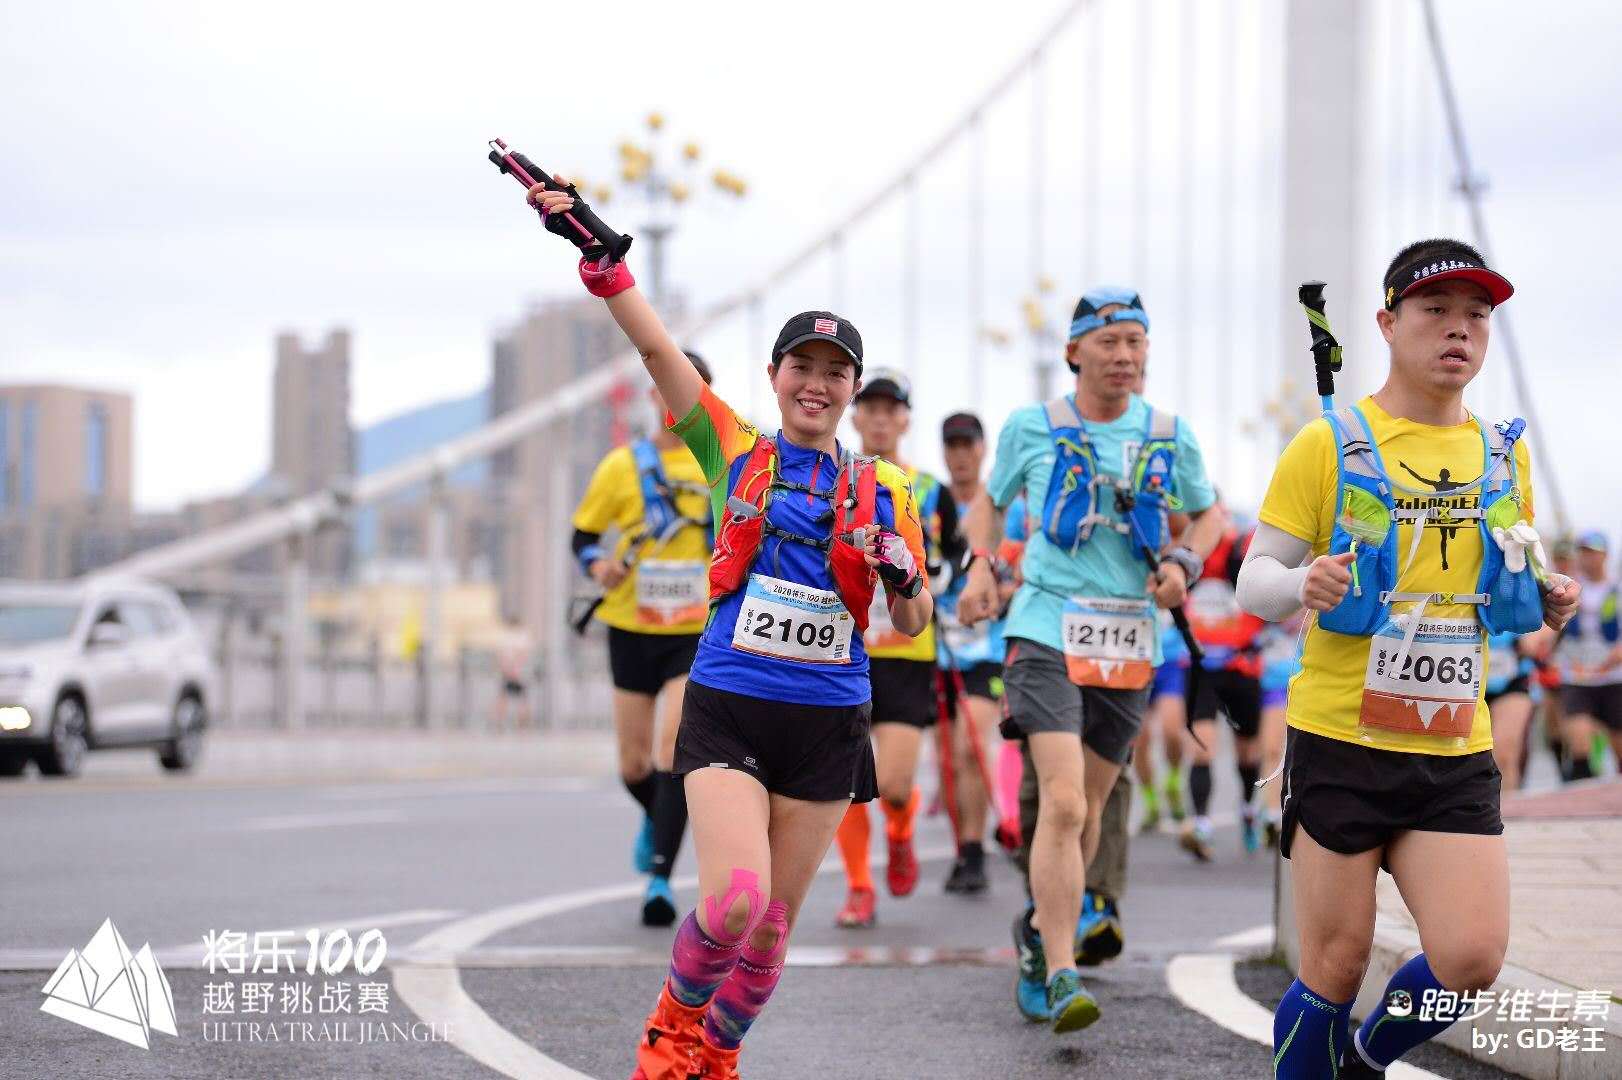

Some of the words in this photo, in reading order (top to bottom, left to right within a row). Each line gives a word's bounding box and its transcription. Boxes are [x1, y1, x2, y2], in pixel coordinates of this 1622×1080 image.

[753, 612, 836, 649] 2109
[1078, 625, 1137, 647] 2114
[1388, 652, 1473, 685] 2063
[1300, 992, 1340, 1014] SPORTS
